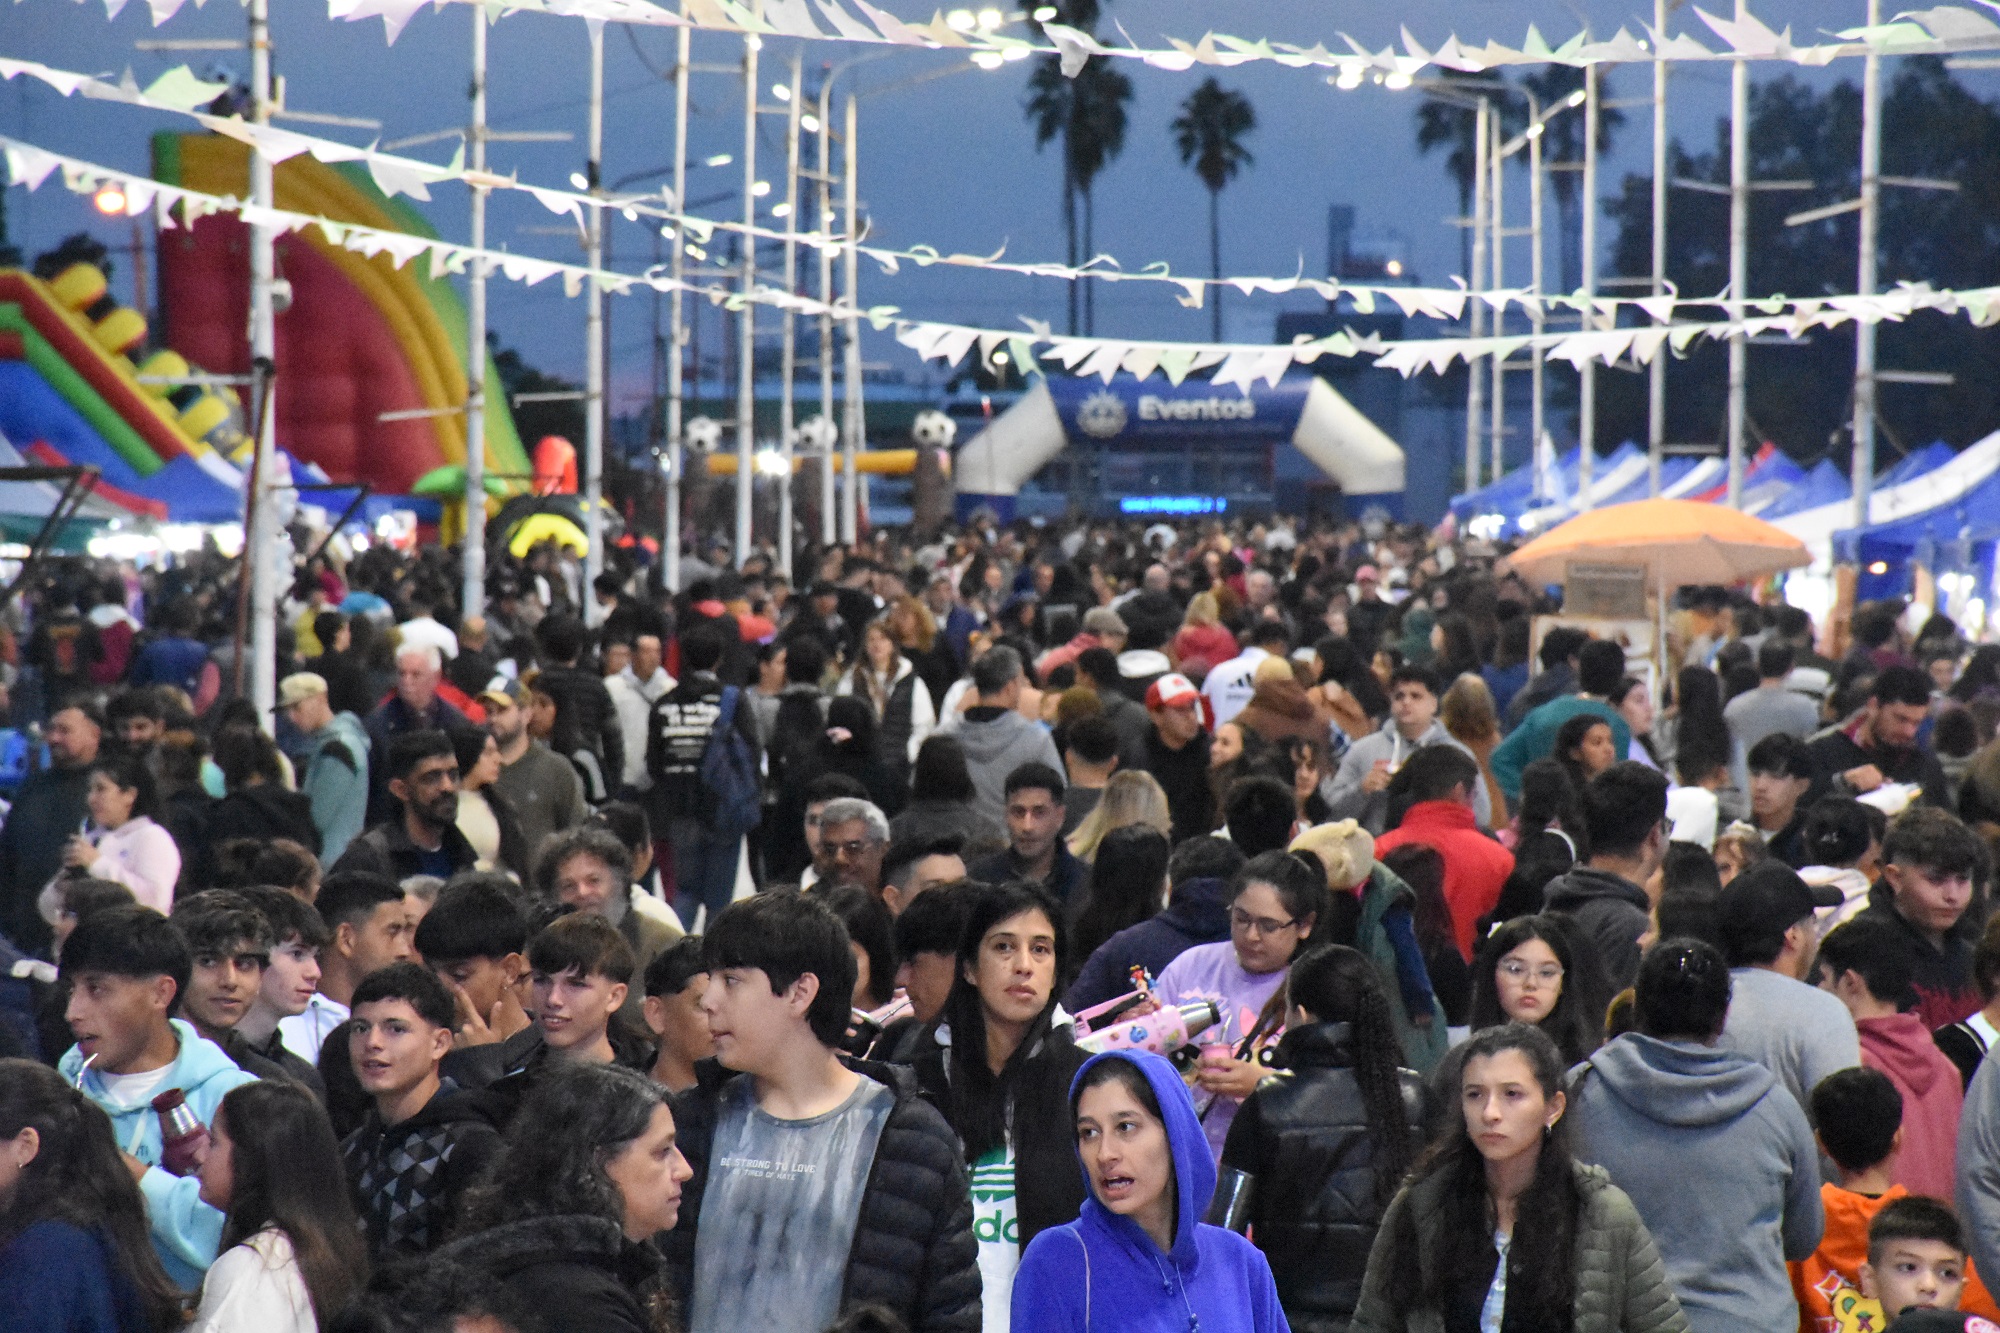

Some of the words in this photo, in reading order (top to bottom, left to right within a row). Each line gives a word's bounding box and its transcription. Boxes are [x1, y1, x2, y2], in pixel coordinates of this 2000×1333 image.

[1138, 394, 1255, 420] Eventos
[720, 1158, 730, 1166] BE
[735, 1159, 771, 1169] STRONG
[775, 1161, 788, 1172] TO
[792, 1164, 816, 1173] LOVE
